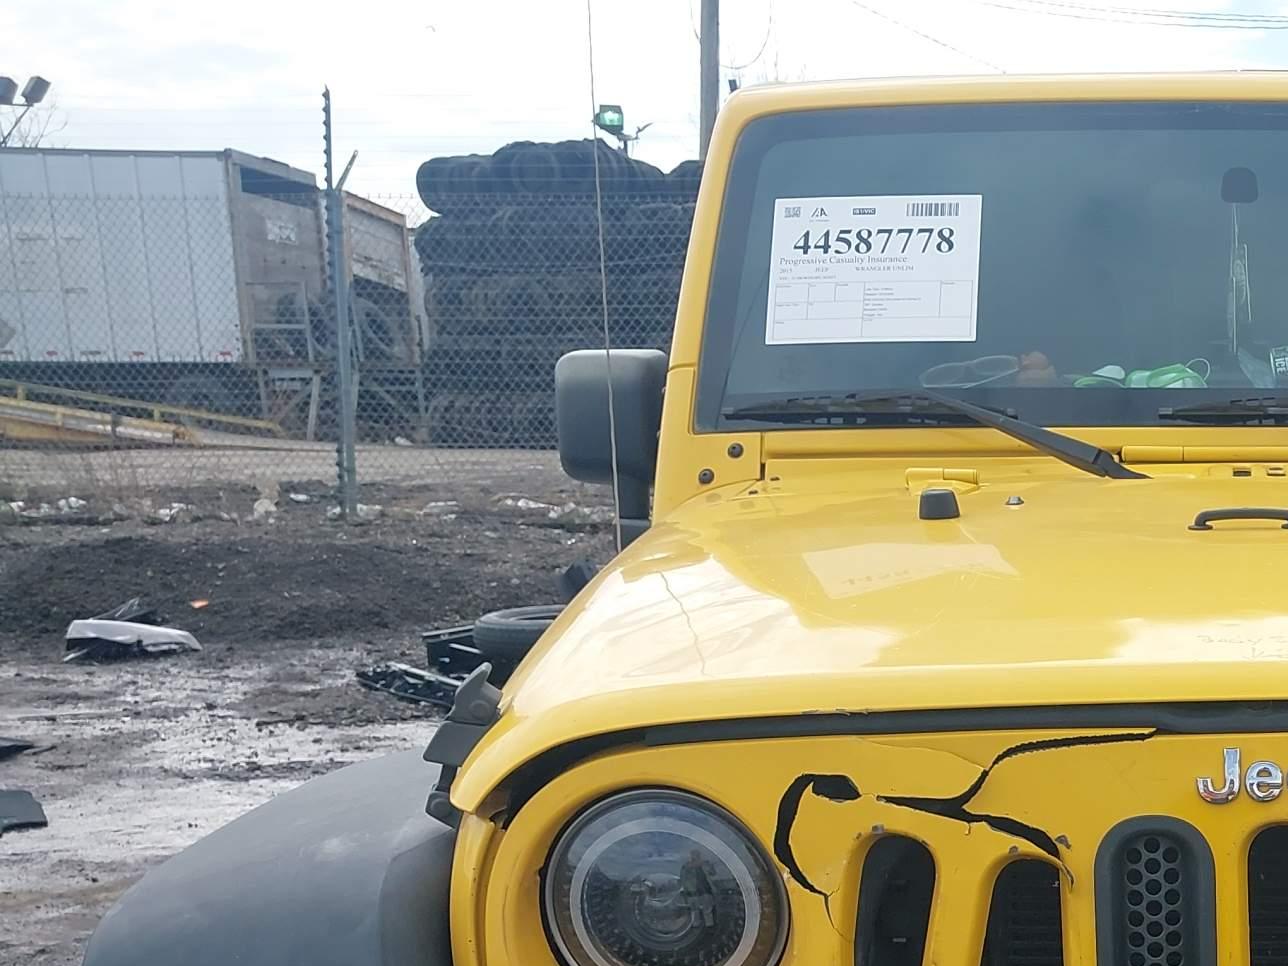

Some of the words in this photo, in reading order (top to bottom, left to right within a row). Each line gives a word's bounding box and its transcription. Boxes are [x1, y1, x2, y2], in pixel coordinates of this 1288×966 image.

[793, 228, 954, 254] 44587778
[779, 256, 826, 267] Progressive
[829, 255, 865, 265] Casualty
[868, 254, 908, 264] Insurance
